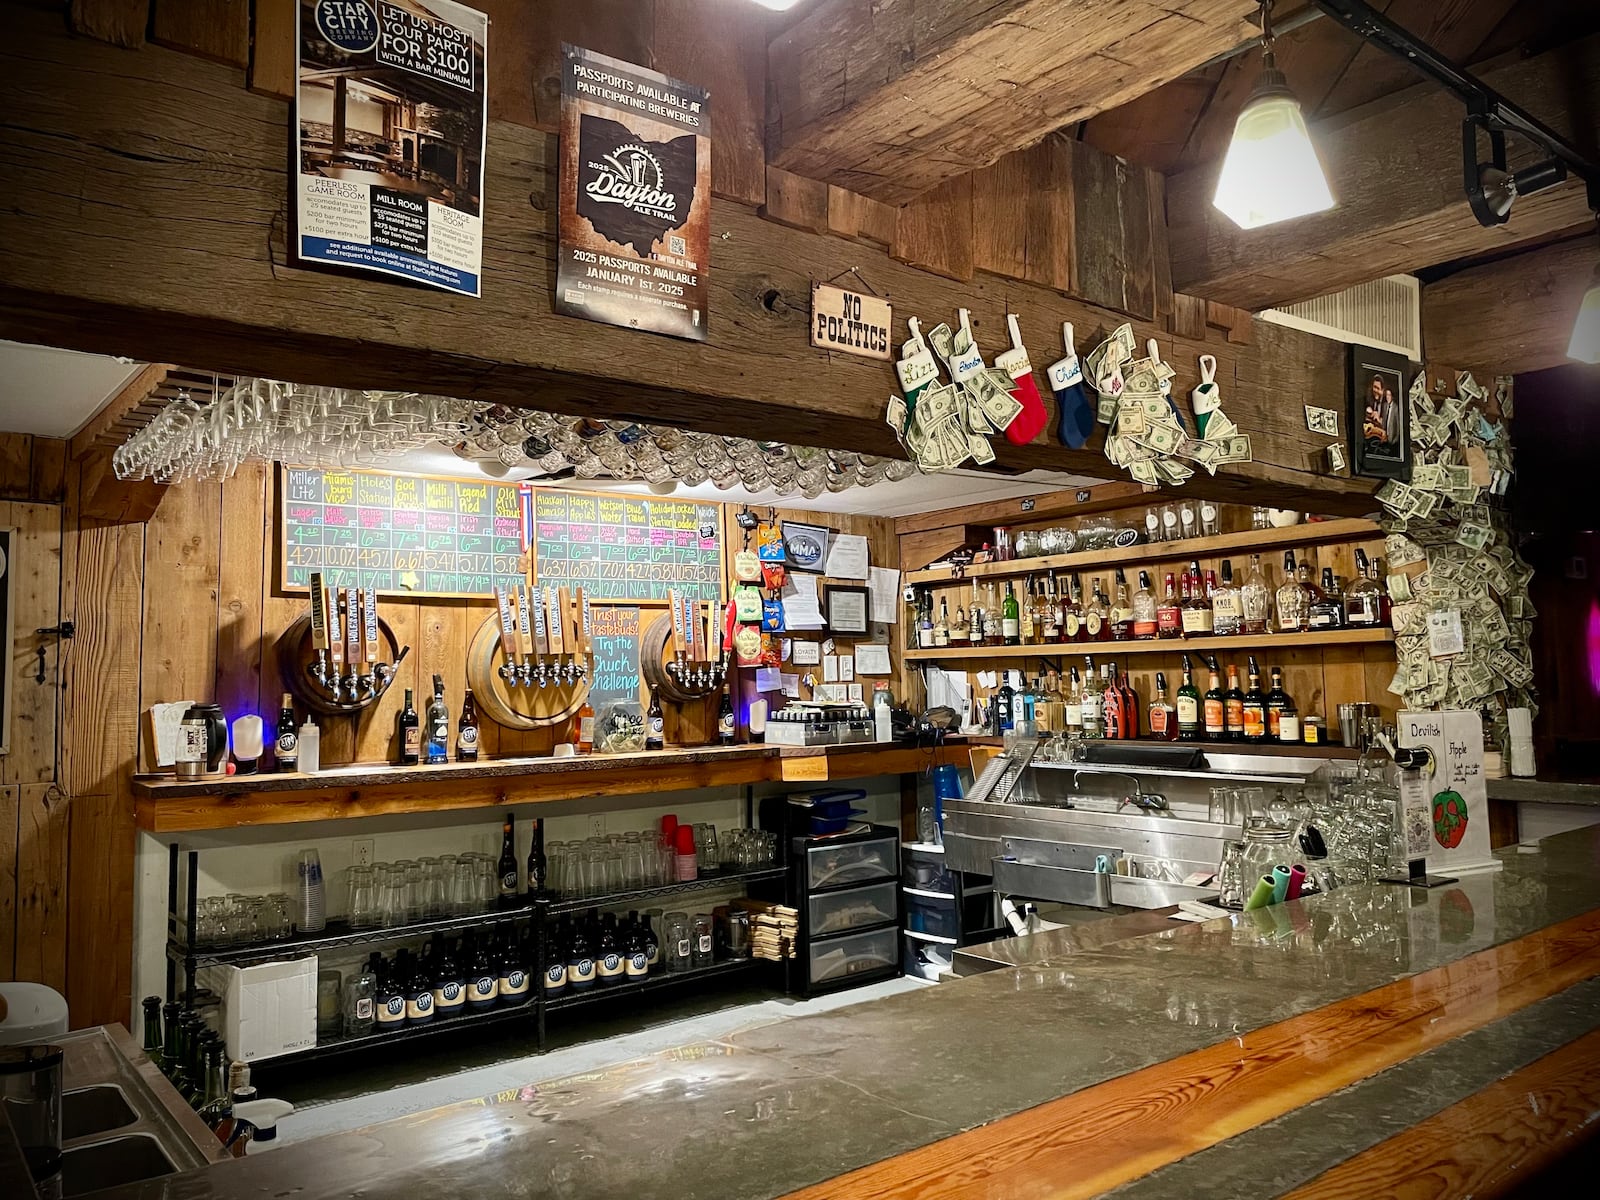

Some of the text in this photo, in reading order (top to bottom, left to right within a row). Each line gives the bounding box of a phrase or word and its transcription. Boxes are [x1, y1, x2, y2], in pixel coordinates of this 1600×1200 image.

[322, 0, 366, 16] STAR
[325, 15, 368, 30] CITY
[382, 6, 469, 43] LET US HOST
[330, 34, 374, 42] COMPANY
[383, 19, 469, 57] YOUR PARTY
[382, 33, 469, 74] FOR $100
[381, 51, 470, 86] WITH A BAR MINIMUM
[573, 64, 702, 115] PASSPORTS AVAILABLE AT
[576, 80, 700, 128] PARTICIPATING BREWERIES
[588, 161, 609, 172] 2025
[307, 185, 366, 201] GAME ROOM
[315, 179, 358, 192] PEERLESS
[586, 173, 677, 210] Dayton
[320, 203, 341, 212] seated
[342, 206, 363, 216] guests
[376, 193, 424, 213] MILL ROOM
[324, 212, 334, 220] bar
[335, 215, 367, 226] minimum
[419, 218, 426, 226] to
[437, 206, 470, 224] HERITAGE
[633, 205, 678, 223] ALE TRAIL
[315, 217, 358, 231] for two hours
[385, 215, 404, 225] seated
[405, 220, 423, 231] guests
[443, 215, 464, 230] ROOM
[325, 228, 336, 236] per
[337, 231, 353, 239] extra
[354, 232, 369, 241] hour
[388, 224, 398, 232] bar
[399, 226, 426, 241] minimum
[390, 231, 402, 239] two
[402, 234, 418, 244] hours
[390, 240, 400, 248] per
[400, 242, 414, 252] extra
[414, 246, 427, 256] hour
[325, 247, 338, 256] and
[339, 249, 362, 262] request
[363, 252, 372, 260] to
[371, 254, 387, 264] book
[387, 258, 405, 269] online
[405, 261, 412, 270] at
[341, 243, 373, 255] additional
[373, 249, 399, 260] available
[429, 262, 440, 271] and
[685, 259, 698, 271] TRAIL
[573, 250, 697, 287] 2025 PASSPORTS AVAILABLE
[586, 267, 635, 286] JANUARY
[658, 282, 685, 297] 2025
[577, 281, 592, 291] Each
[593, 284, 611, 295] stamp
[611, 288, 634, 300] requires
[843, 292, 861, 321] NO
[817, 313, 888, 353] POLITICS
[289, 472, 320, 486] Miller
[395, 479, 415, 492] God
[292, 485, 316, 500] Lite
[359, 490, 391, 505] Station
[426, 483, 447, 496] Milli
[456, 483, 487, 502] Legend
[498, 488, 516, 500] Old
[325, 493, 347, 505] Vice
[459, 498, 480, 514] Red
[495, 498, 517, 509] Mill
[569, 496, 595, 513] Happy
[290, 508, 318, 522] Lager
[460, 515, 479, 524] Irish
[495, 506, 521, 519] Stout
[290, 546, 322, 565] 4.2%
[324, 547, 356, 566] 10.0%
[458, 553, 489, 573] 5.1%
[590, 607, 637, 627] Trust your
[1161, 613, 1171, 621] 46
[590, 622, 640, 636] tastebuds?
[595, 636, 633, 657] Try the
[1410, 723, 1441, 737] Devilish
[1449, 741, 1468, 759] Apple
